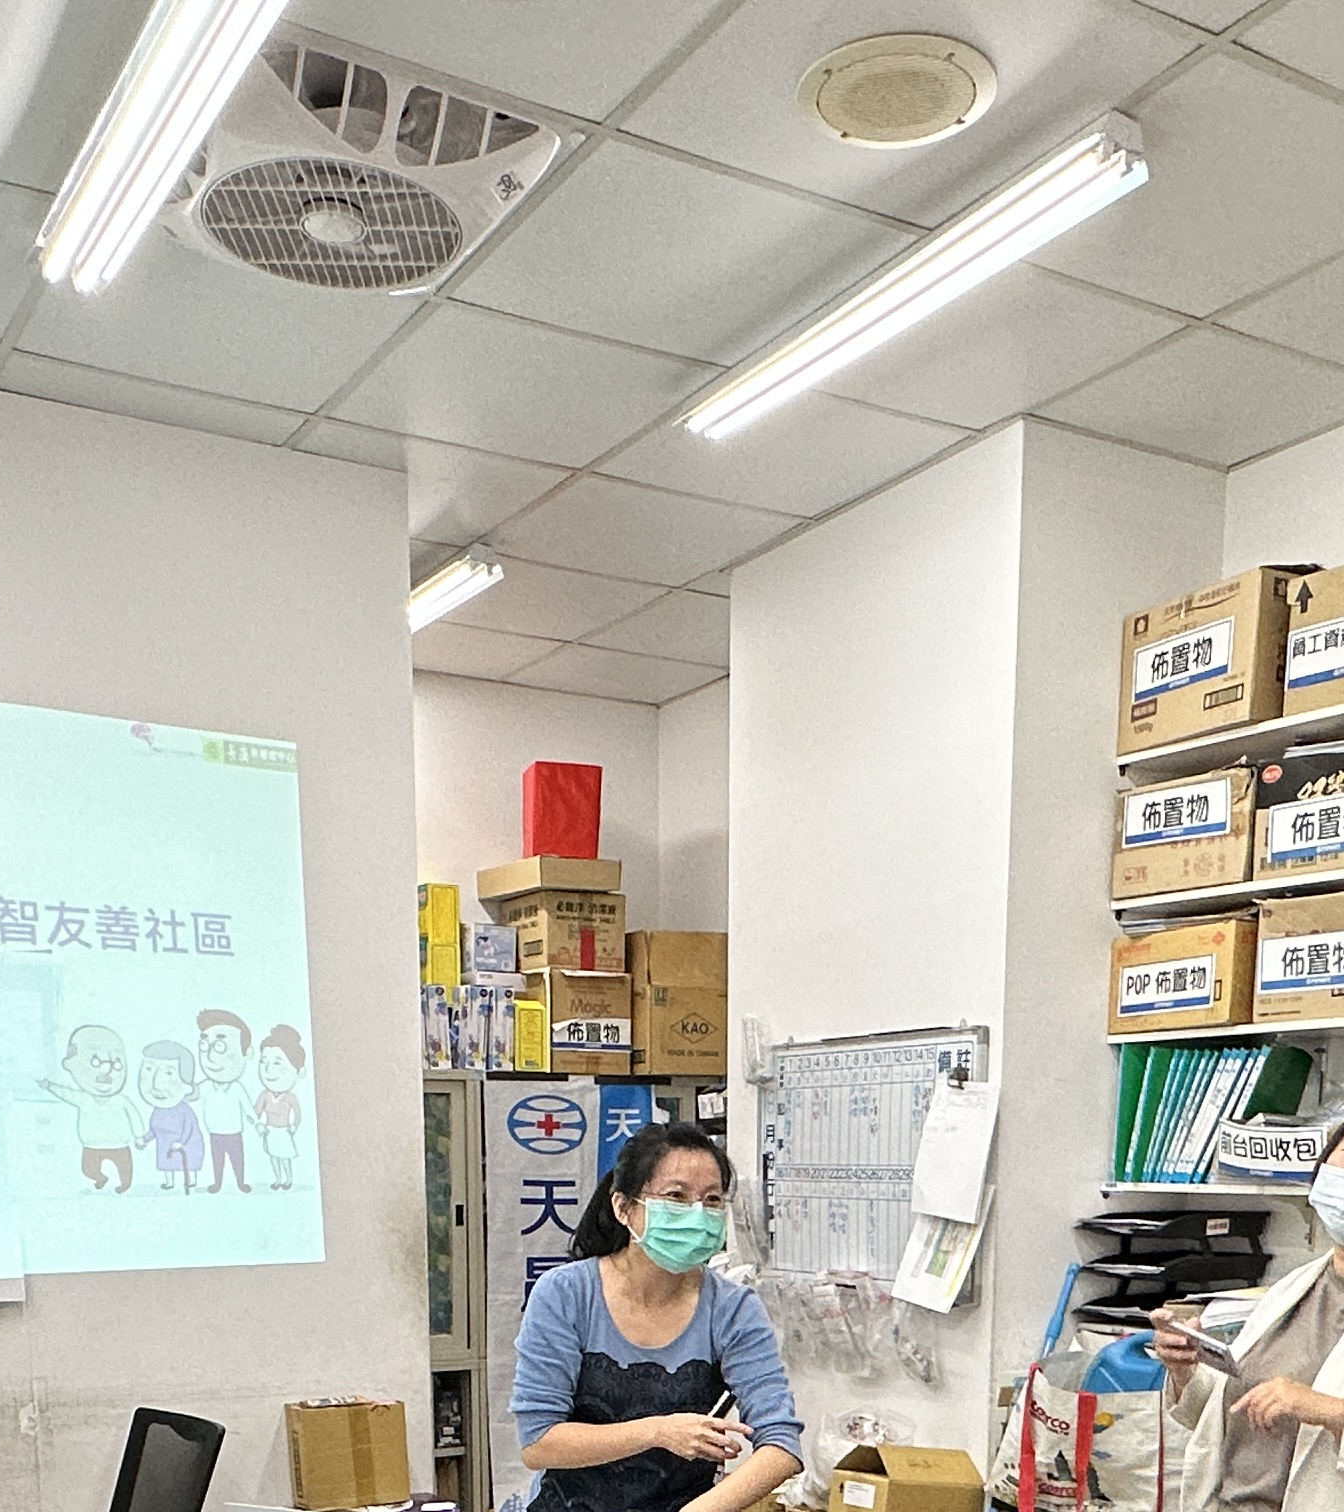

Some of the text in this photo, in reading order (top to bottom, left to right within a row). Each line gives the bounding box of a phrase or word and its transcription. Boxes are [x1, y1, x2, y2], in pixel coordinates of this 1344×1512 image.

[1150, 634, 1213, 684] 佈置物
[1142, 793, 1210, 832] 佈置物
[1126, 965, 1207, 996] POP 佈置物
[569, 998, 612, 1018] Magic
[567, 1021, 621, 1044] 佈置物
[680, 1021, 710, 1035] KAO
[605, 1107, 643, 1142] 天
